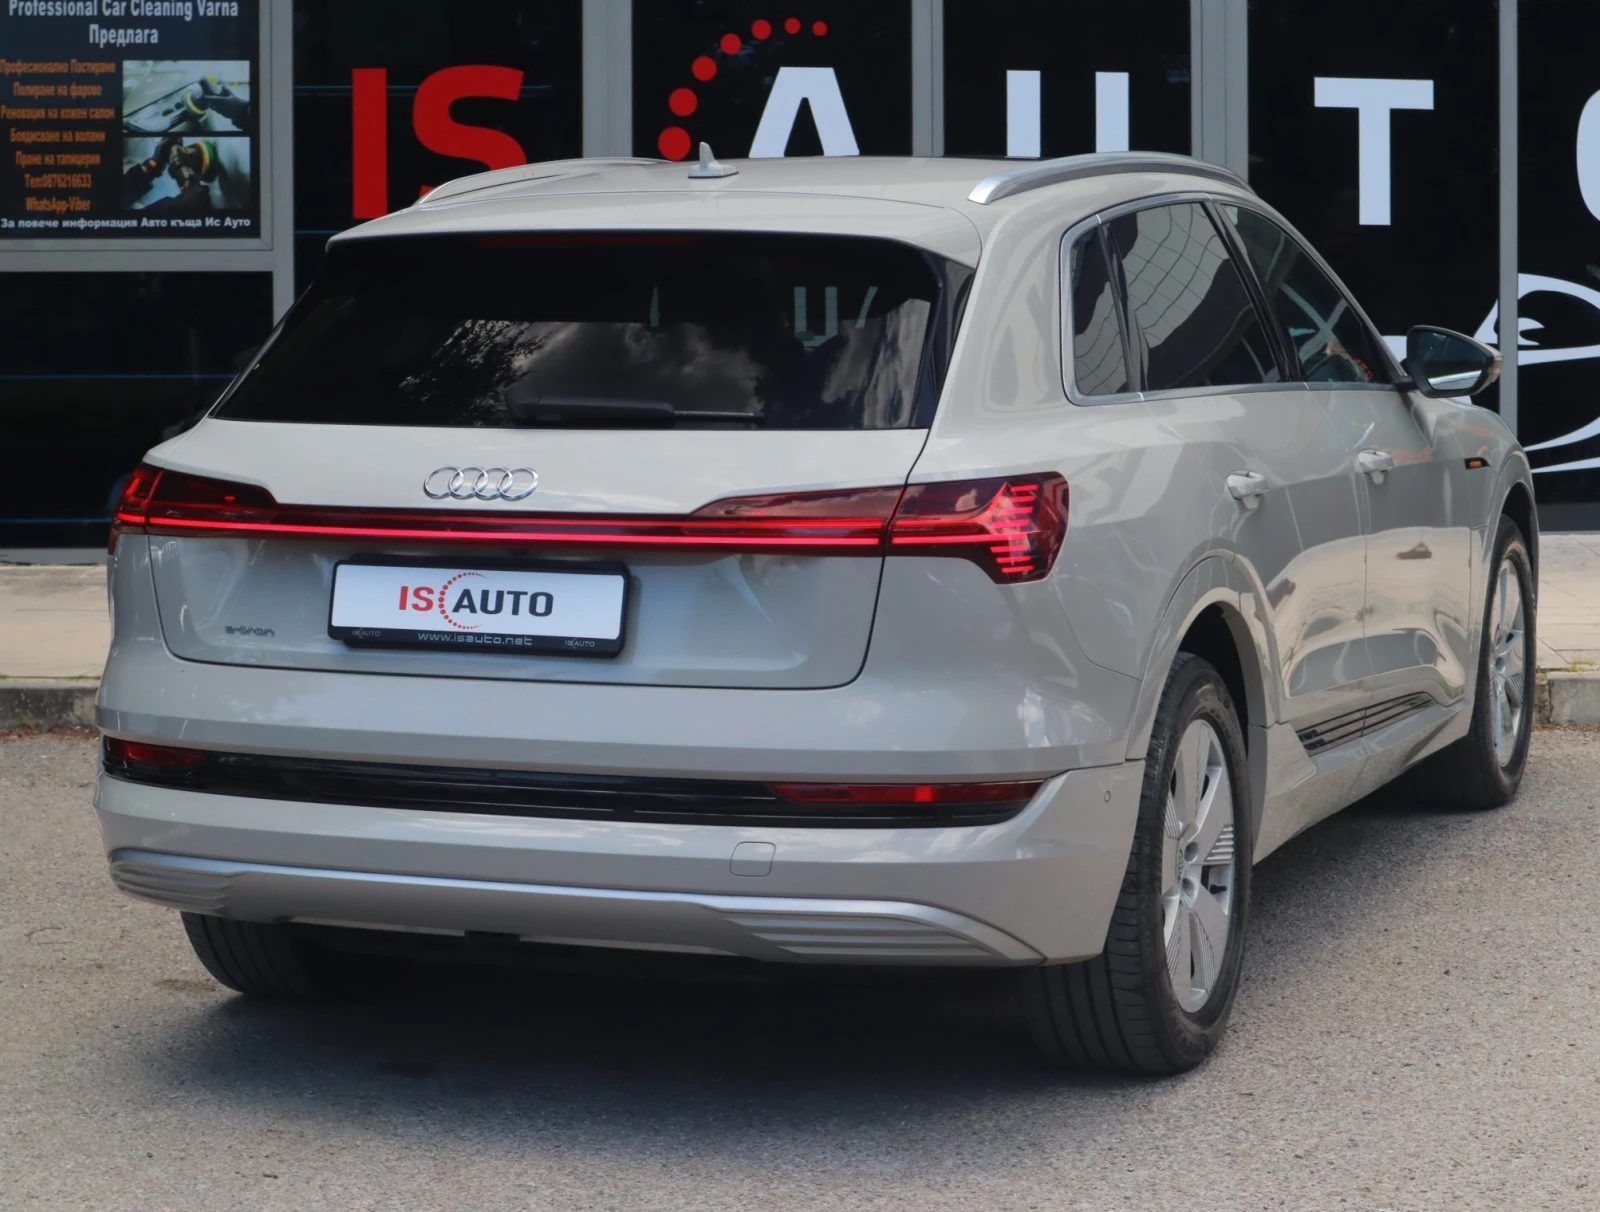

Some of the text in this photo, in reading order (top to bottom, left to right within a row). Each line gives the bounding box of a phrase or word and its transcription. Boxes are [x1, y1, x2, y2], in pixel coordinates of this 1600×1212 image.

[9, 0, 239, 21] Professional Car Cleaning Varna
[88, 24, 159, 48] Предлага
[57, 85, 68, 96] на
[47, 108, 59, 119] на
[62, 131, 73, 142] на
[352, 64, 1600, 226] IS AUT
[44, 154, 55, 165] на
[1, 217, 252, 230] За повече информация Авто къща Ис Ауто
[398, 585, 555, 617] IS AUTO
[417, 632, 533, 647] www.isauto.net
